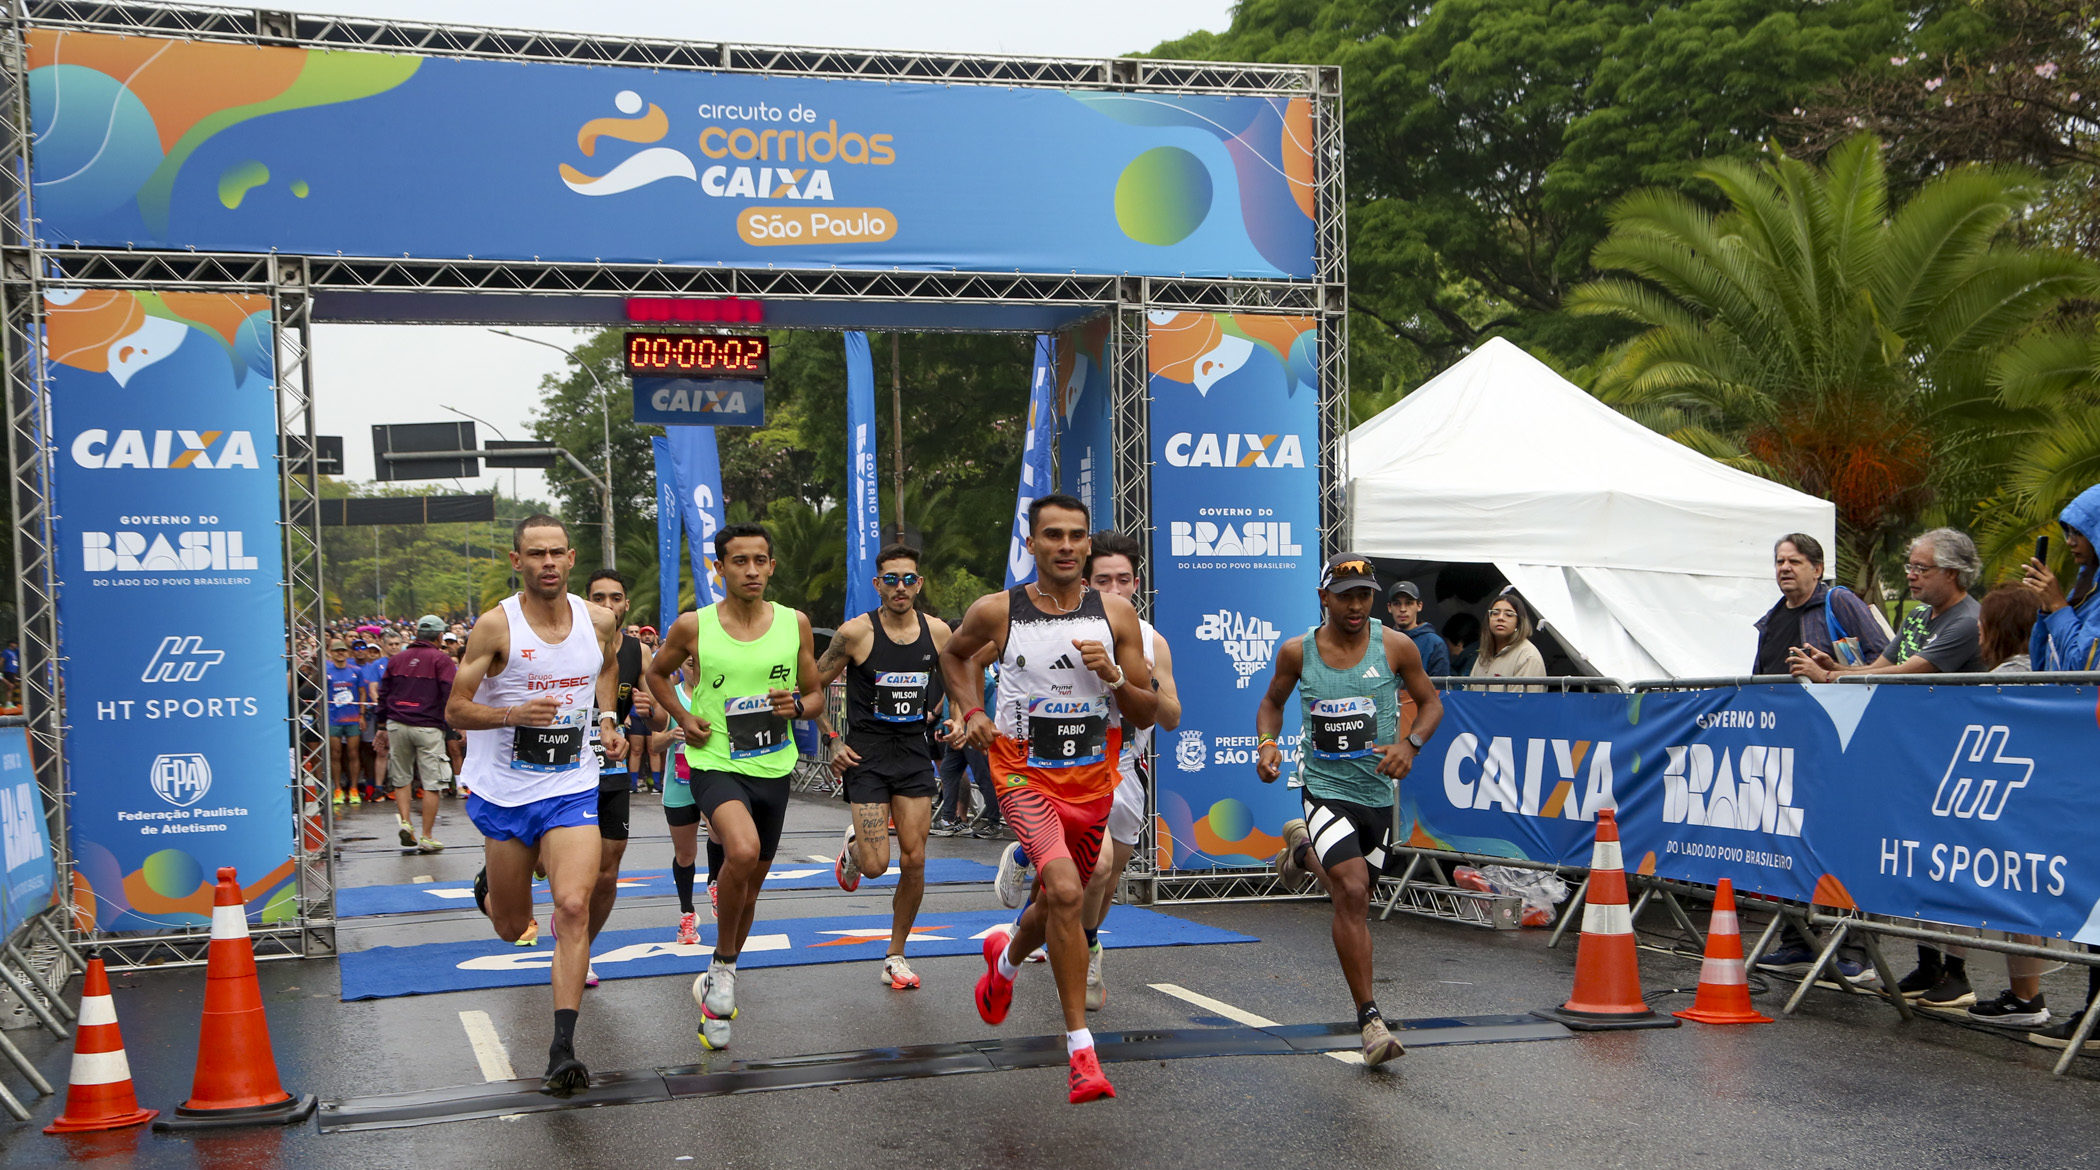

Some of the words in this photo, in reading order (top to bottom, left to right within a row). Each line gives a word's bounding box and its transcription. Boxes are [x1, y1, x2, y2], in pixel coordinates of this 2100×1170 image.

[699, 102, 782, 122] circuito
[788, 104, 816, 123] de
[699, 120, 896, 165] corridas
[701, 165, 835, 200] CAIXA
[748, 213, 802, 239] São
[811, 213, 886, 237] Paulo
[631, 338, 762, 369] 00:00:02
[651, 389, 747, 414] CAIXA
[71, 428, 259, 469] CAIXA
[1165, 432, 1305, 468] CAIXA
[866, 453, 877, 514] GOVERNO
[120, 515, 191, 525] GOVERNO
[199, 515, 219, 525] DO
[1199, 508, 1252, 516] GOVERNO
[1258, 508, 1273, 516] DO
[869, 521, 878, 538] DO
[1171, 521, 1302, 556] BRASIL
[82, 531, 258, 571] BRASIL
[93, 579, 107, 587] DO
[112, 578, 140, 587] LADO
[143, 578, 159, 587] DO
[162, 578, 191, 587] POVO
[194, 577, 251, 585] BRASILEIRO
[1196, 609, 1281, 640] BRAZIL
[1223, 641, 1275, 661] RUN
[769, 665, 790, 681] BR
[1233, 662, 1267, 675] SERIES
[528, 673, 553, 681] Grupo
[887, 676, 917, 684] CAIXA
[892, 691, 917, 699] WILSON
[97, 700, 135, 720] HT
[145, 697, 258, 719] SPORTS
[738, 698, 768, 710] CAIX
[894, 702, 910, 714] 10
[1044, 702, 1090, 713] CAIXA
[1320, 701, 1357, 713] CAIXA
[1324, 720, 1364, 732] GUSTAVO
[1696, 711, 1755, 729] GOVERNO
[1760, 711, 1776, 729] DO
[1057, 724, 1086, 735] FABIO
[538, 734, 569, 744] FLAVIO
[755, 730, 771, 746] 11
[1215, 736, 1285, 747] PREFEITA
[1338, 735, 1349, 750] 5
[546, 748, 555, 763] 1
[1062, 740, 1076, 756] 8
[1214, 748, 1249, 764] SÃO
[162, 759, 200, 798] FPA
[1443, 732, 1619, 822] CAIXA
[1662, 743, 1804, 838] BRASIL
[117, 809, 190, 823] Federação
[193, 807, 249, 818] Paulista
[140, 825, 158, 835] de
[161, 822, 227, 834] Atletismo
[1666, 840, 1679, 853] DO
[1681, 842, 1704, 857] LADO
[1705, 846, 1717, 859] DO
[1719, 846, 1743, 862] POVO
[1745, 850, 1793, 871] BRASILEIRO
[1880, 838, 1920, 878] HT
[1928, 843, 2068, 896] SPORTS
